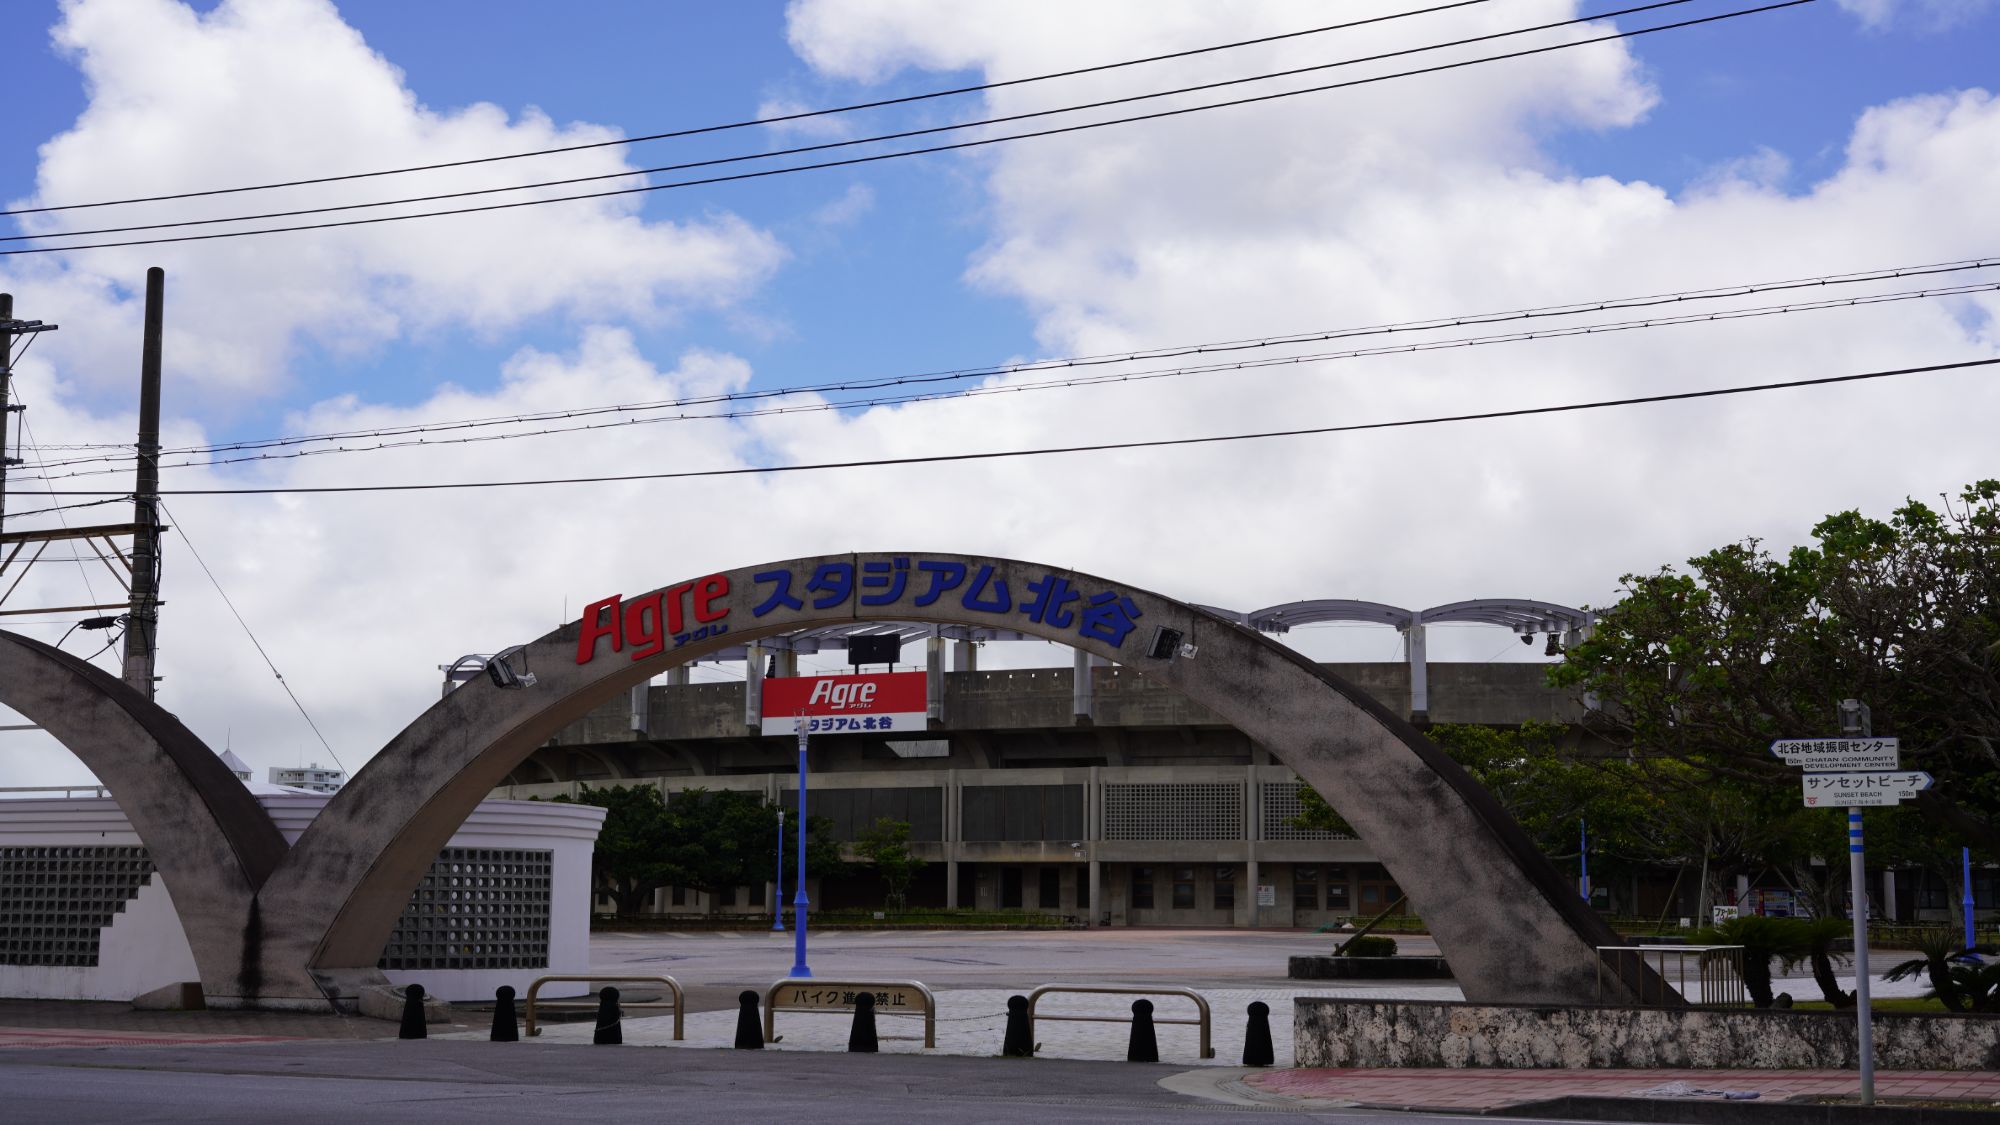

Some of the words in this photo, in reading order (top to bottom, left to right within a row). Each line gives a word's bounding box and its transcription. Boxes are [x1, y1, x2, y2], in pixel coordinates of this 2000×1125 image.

[753, 557, 1142, 648] スタジアム北谷
[576, 573, 730, 665] Agre
[673, 624, 729, 648] アグレ
[809, 679, 877, 710] Agre
[1778, 741, 1895, 754] 北谷地域振興センター
[1807, 775, 1922, 789] サンセットビーチ
[794, 990, 906, 1006] バイク進禁止
